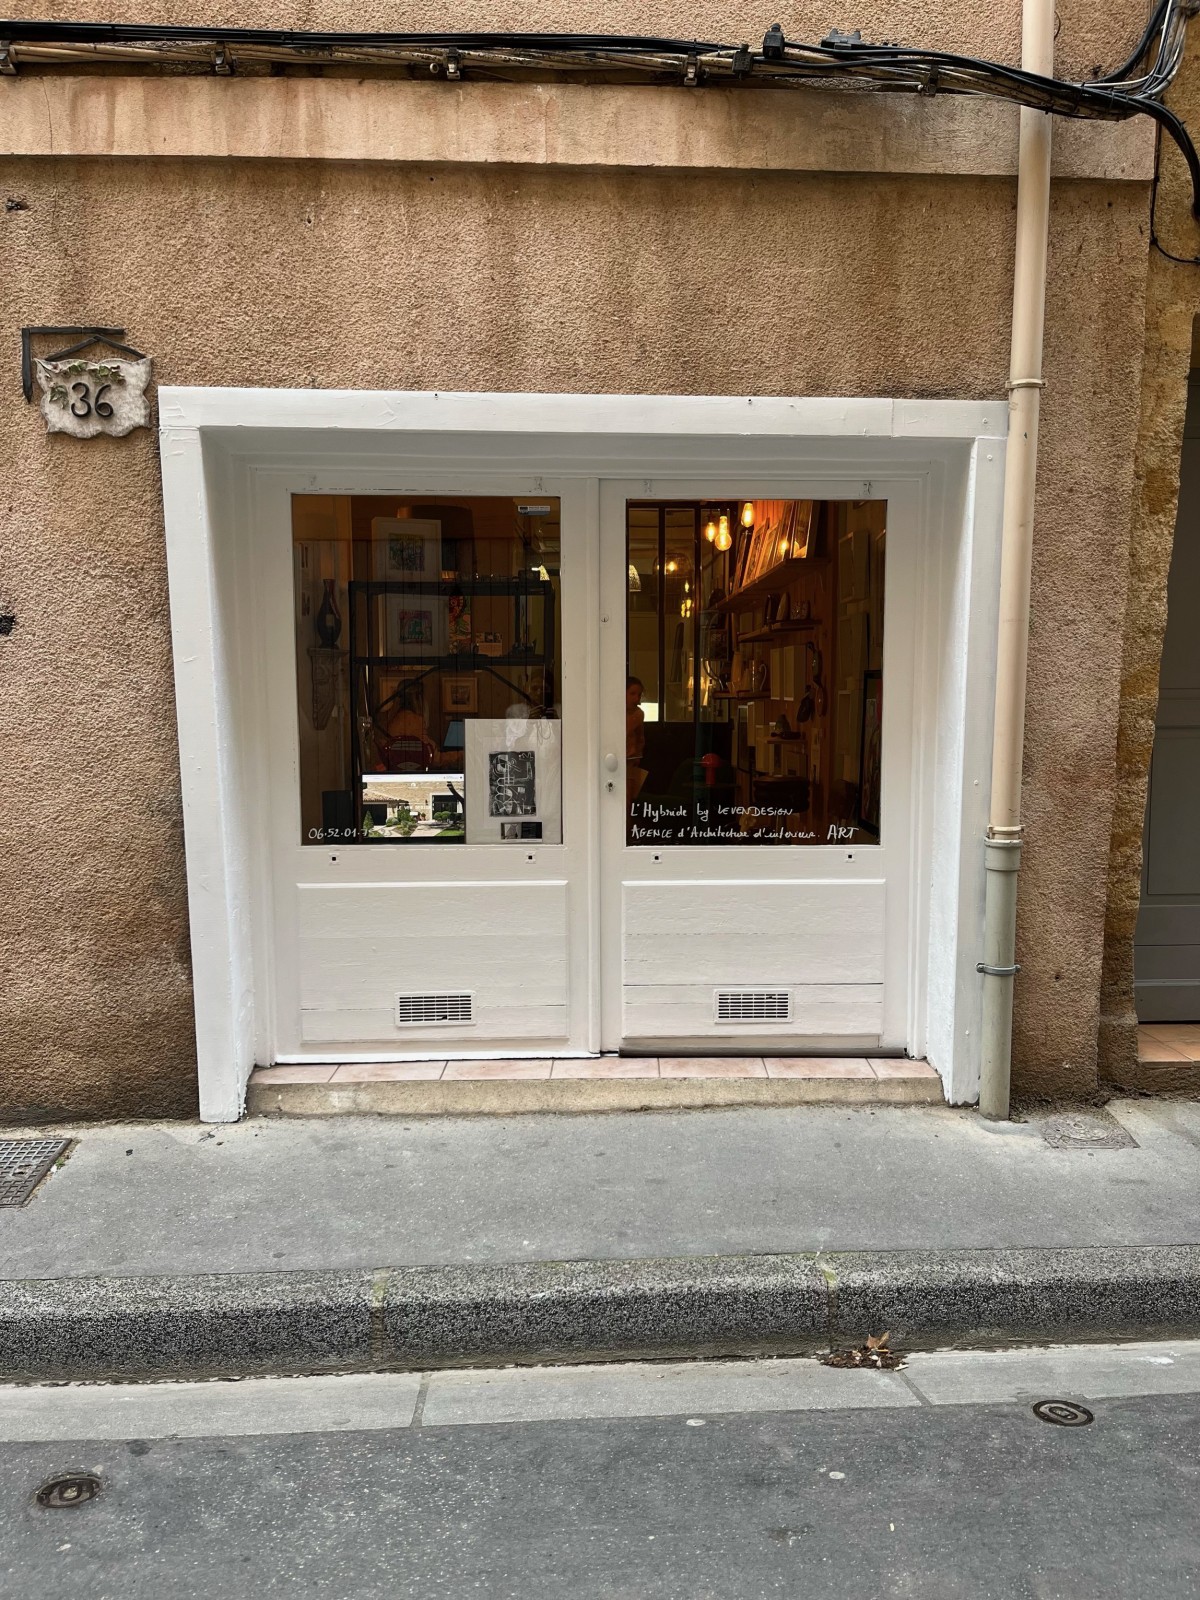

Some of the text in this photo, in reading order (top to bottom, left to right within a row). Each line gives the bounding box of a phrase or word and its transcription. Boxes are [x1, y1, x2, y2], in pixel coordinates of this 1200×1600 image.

[71, 382, 114, 418] 36
[696, 802, 709, 822] by
[631, 824, 673, 839] AGENCE
[827, 824, 860, 840] ART
